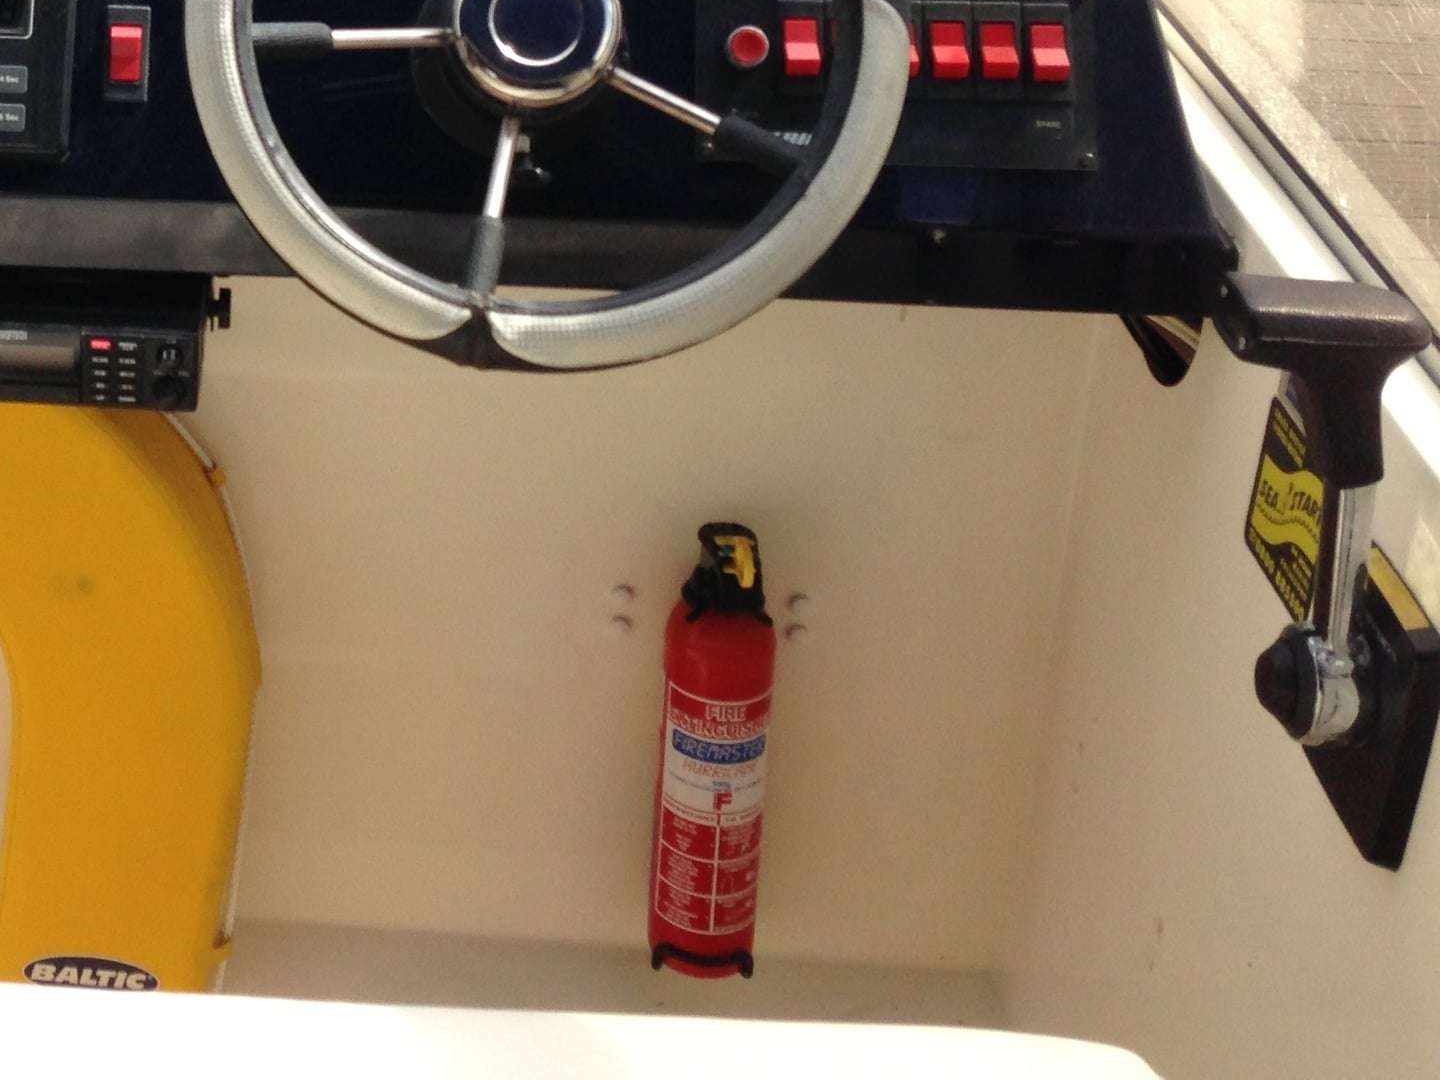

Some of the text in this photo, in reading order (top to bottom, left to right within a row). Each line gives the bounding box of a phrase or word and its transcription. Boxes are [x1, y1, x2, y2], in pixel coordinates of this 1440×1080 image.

[1260, 480, 1278, 509] SEA
[705, 704, 747, 722] FIRE
[31, 963, 147, 990] BALTIC
